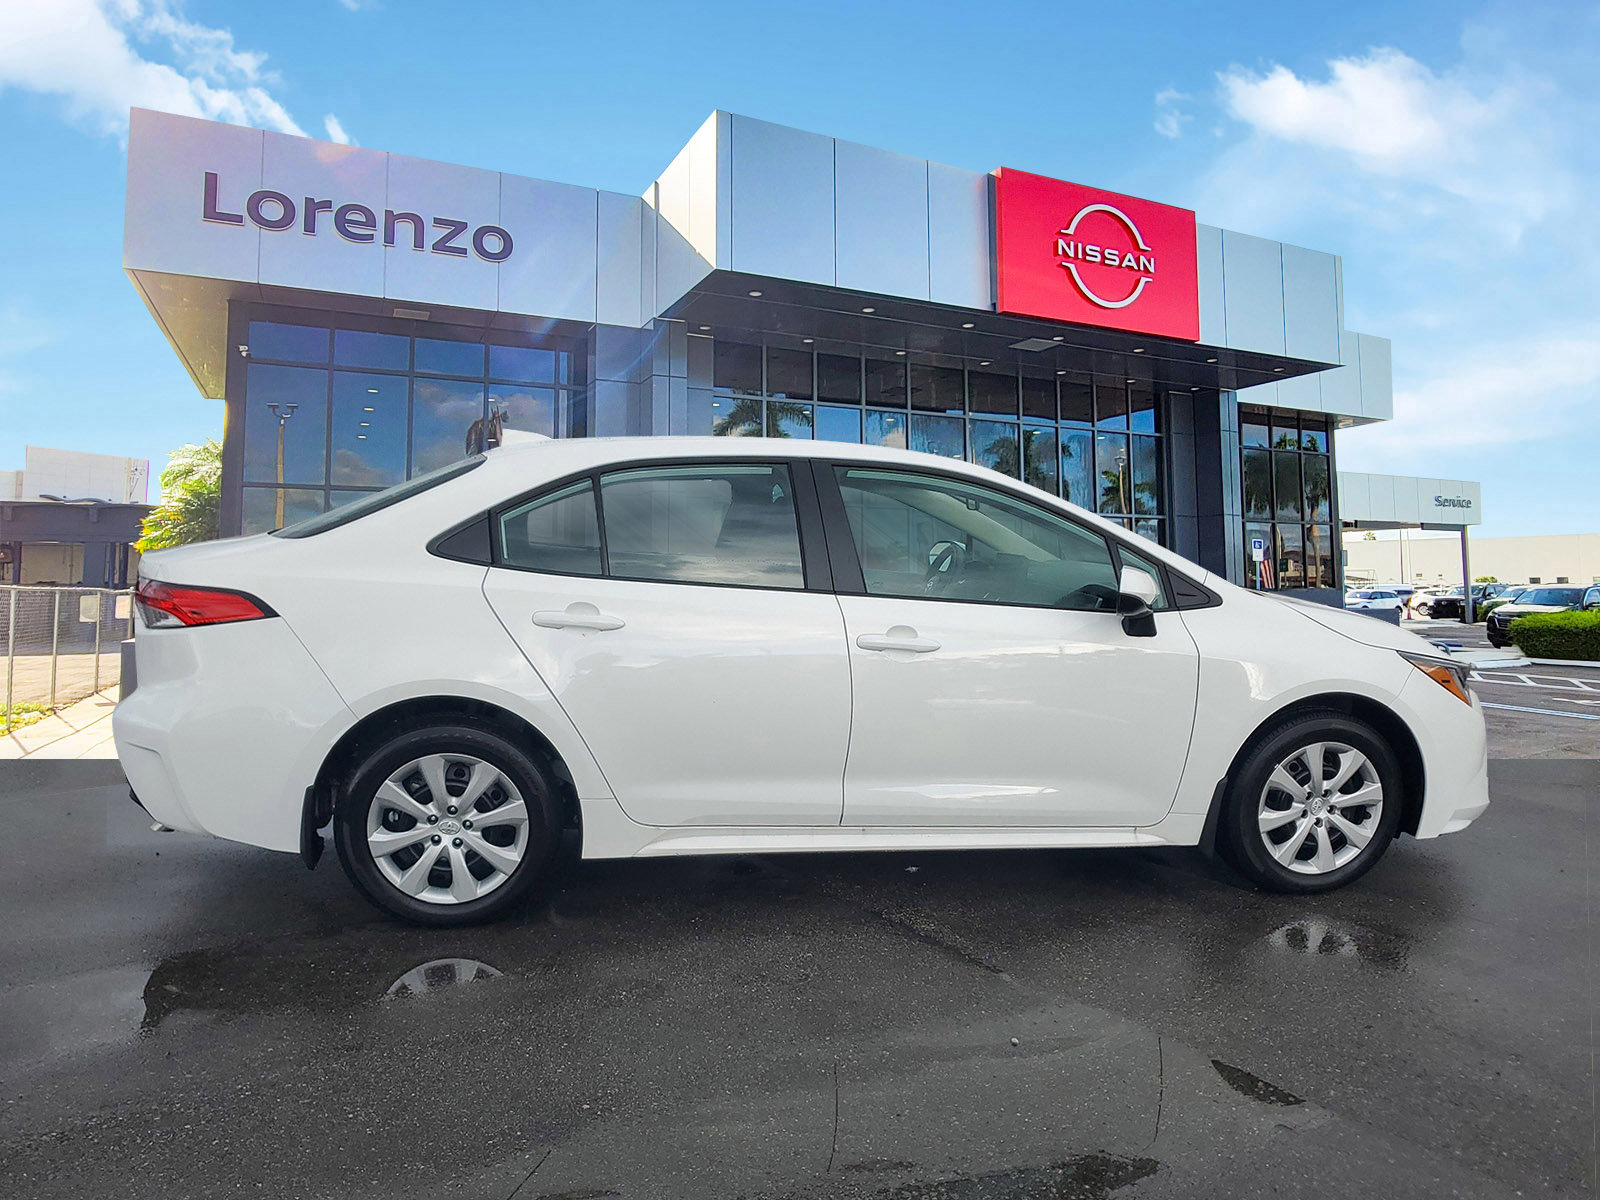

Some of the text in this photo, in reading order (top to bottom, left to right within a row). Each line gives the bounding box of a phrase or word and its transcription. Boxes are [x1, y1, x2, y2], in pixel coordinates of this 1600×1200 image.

[202, 170, 514, 263] Lorenzo
[1056, 238, 1155, 273] NISSAN
[1434, 495, 1472, 508] Service
